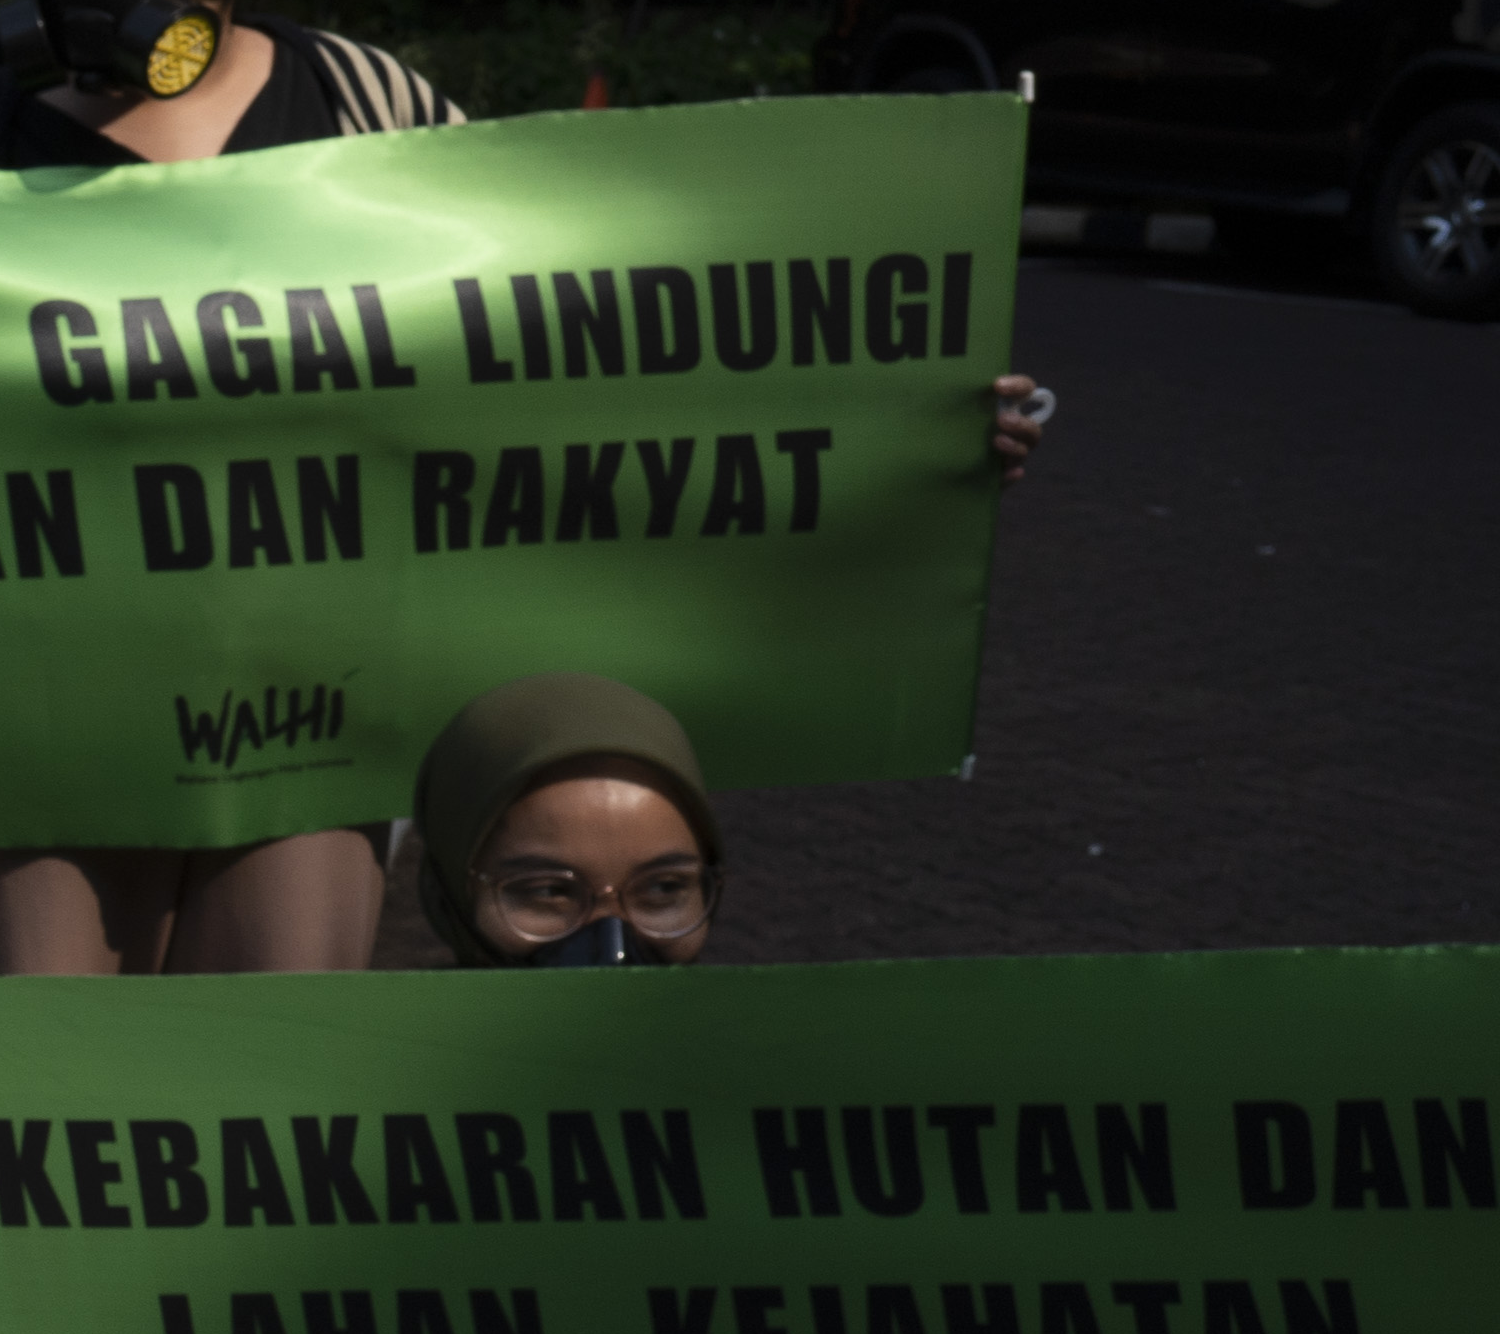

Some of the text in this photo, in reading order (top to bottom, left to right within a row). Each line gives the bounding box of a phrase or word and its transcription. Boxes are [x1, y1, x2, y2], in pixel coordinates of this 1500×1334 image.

[26, 281, 416, 407] GAGAL
[450, 251, 976, 383] LINDUNGI
[134, 451, 365, 575] DAN
[410, 428, 834, 556] RAKYAT
[174, 683, 344, 771] WALHI
[752, 1101, 1178, 1219] HUTAN
[1232, 1097, 1499, 1212] DAN
